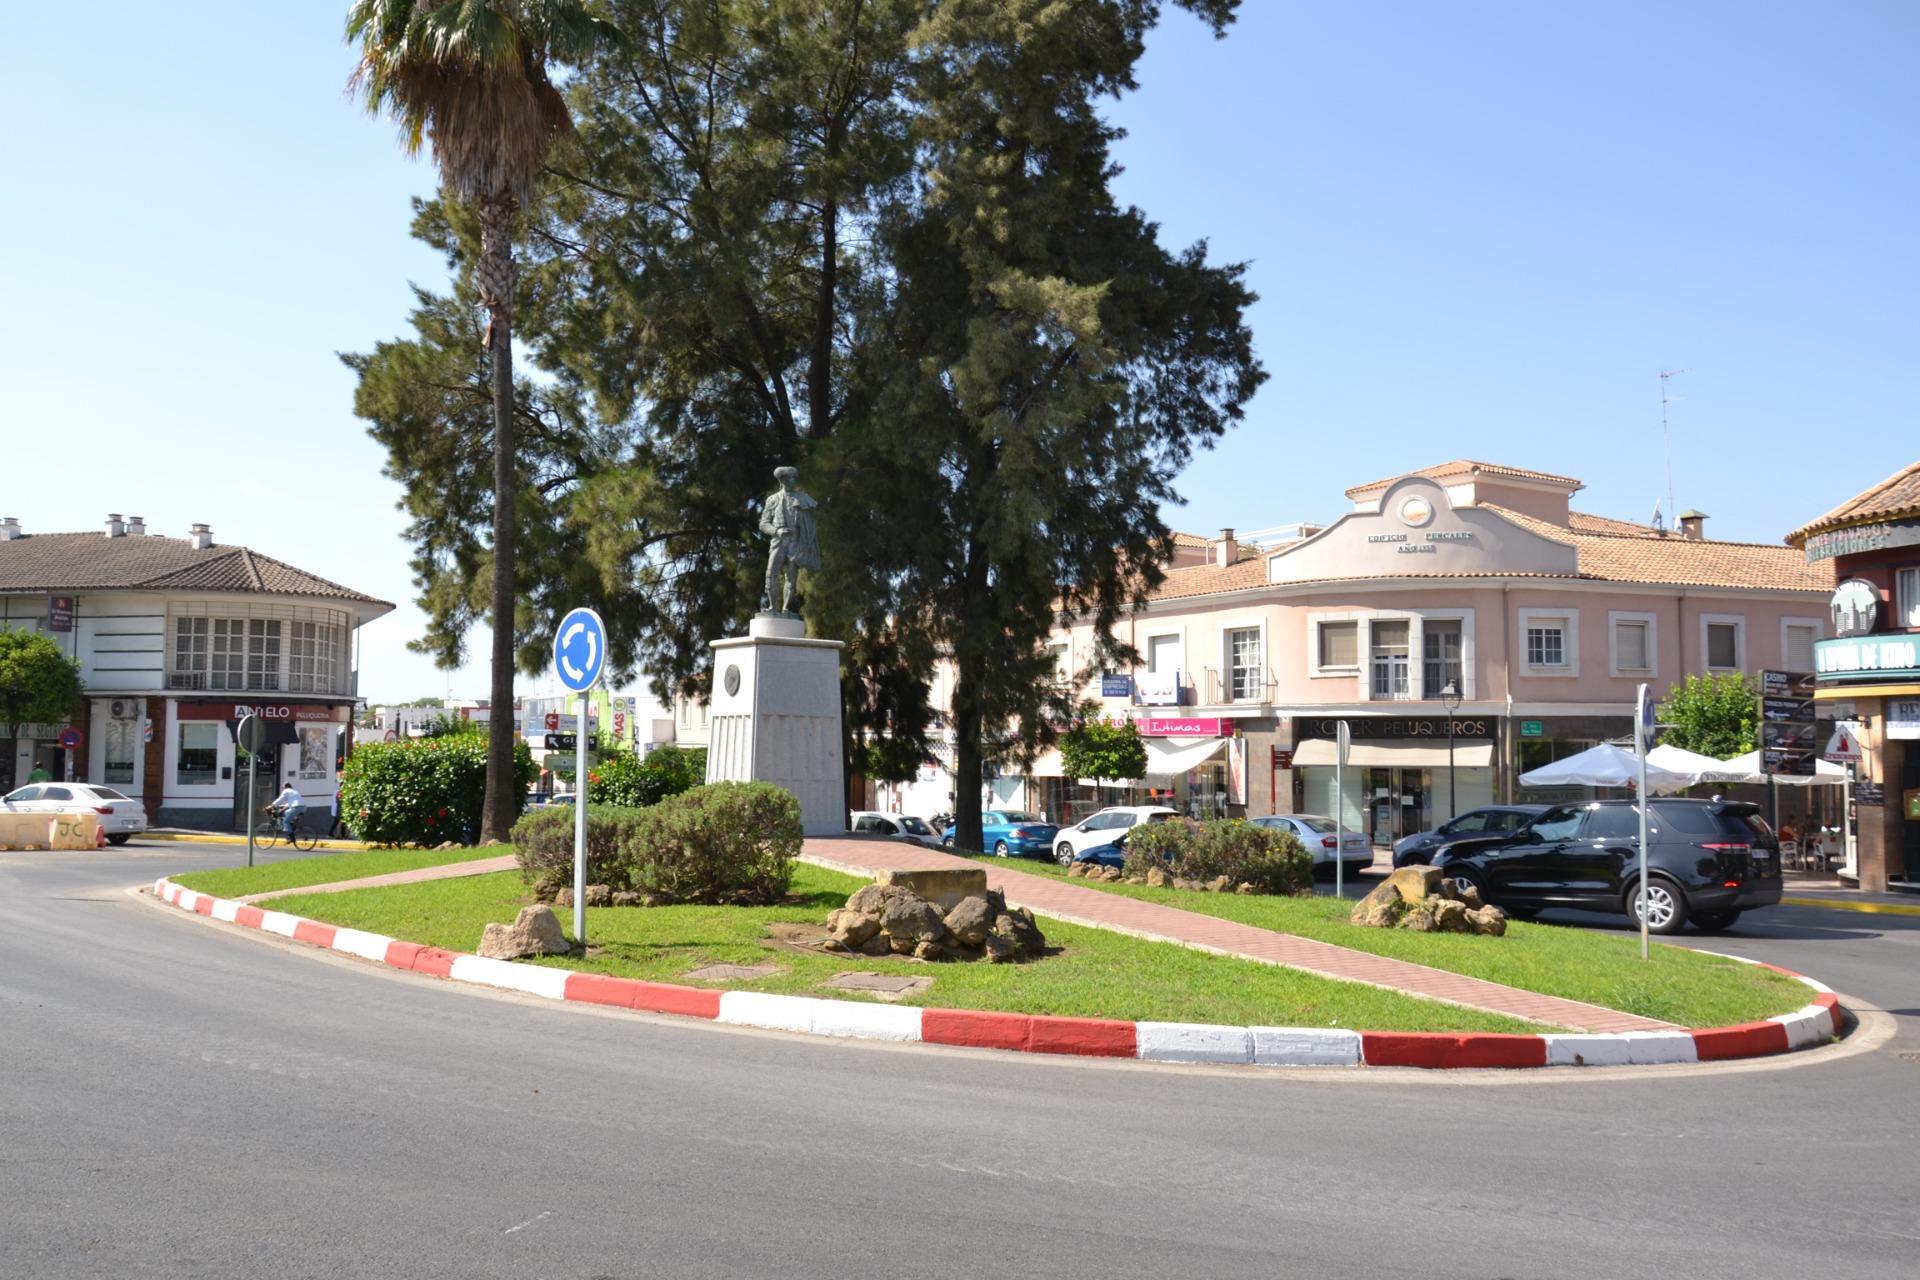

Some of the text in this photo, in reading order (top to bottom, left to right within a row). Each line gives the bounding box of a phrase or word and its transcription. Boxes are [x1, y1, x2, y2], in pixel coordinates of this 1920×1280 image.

[1368, 535, 1407, 543] EDIFICIO
[235, 705, 290, 718] ANTELO
[1384, 721, 1485, 735] PELUQUEROS
